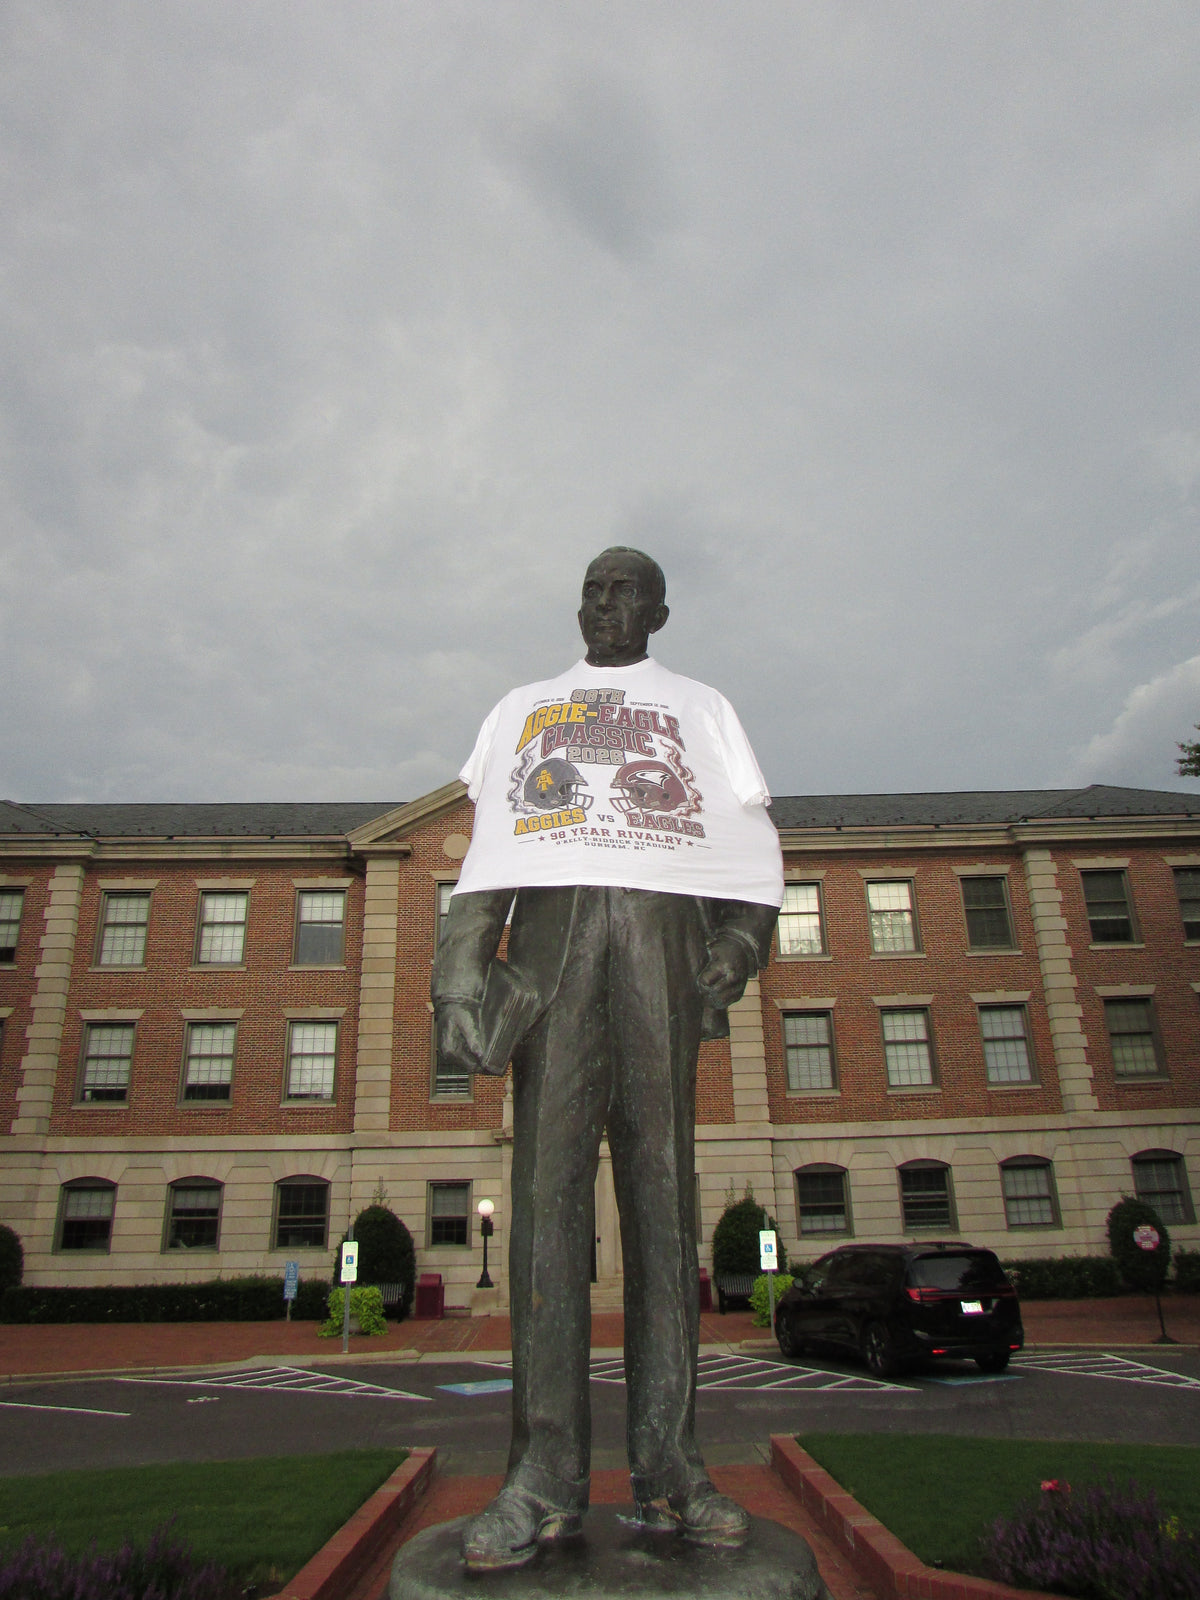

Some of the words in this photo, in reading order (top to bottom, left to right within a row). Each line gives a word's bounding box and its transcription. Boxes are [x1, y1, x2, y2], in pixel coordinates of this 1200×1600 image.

[541, 723, 657, 759] CLASSIC
[566, 746, 627, 765] 2026
[514, 807, 588, 836] AGGIES
[597, 814, 615, 823] VS
[624, 811, 706, 839] EAGLES
[550, 831, 566, 841] 98
[571, 827, 611, 837] YEAR
[618, 829, 682, 846] RIVALRY
[635, 840, 675, 850] STADIUM
